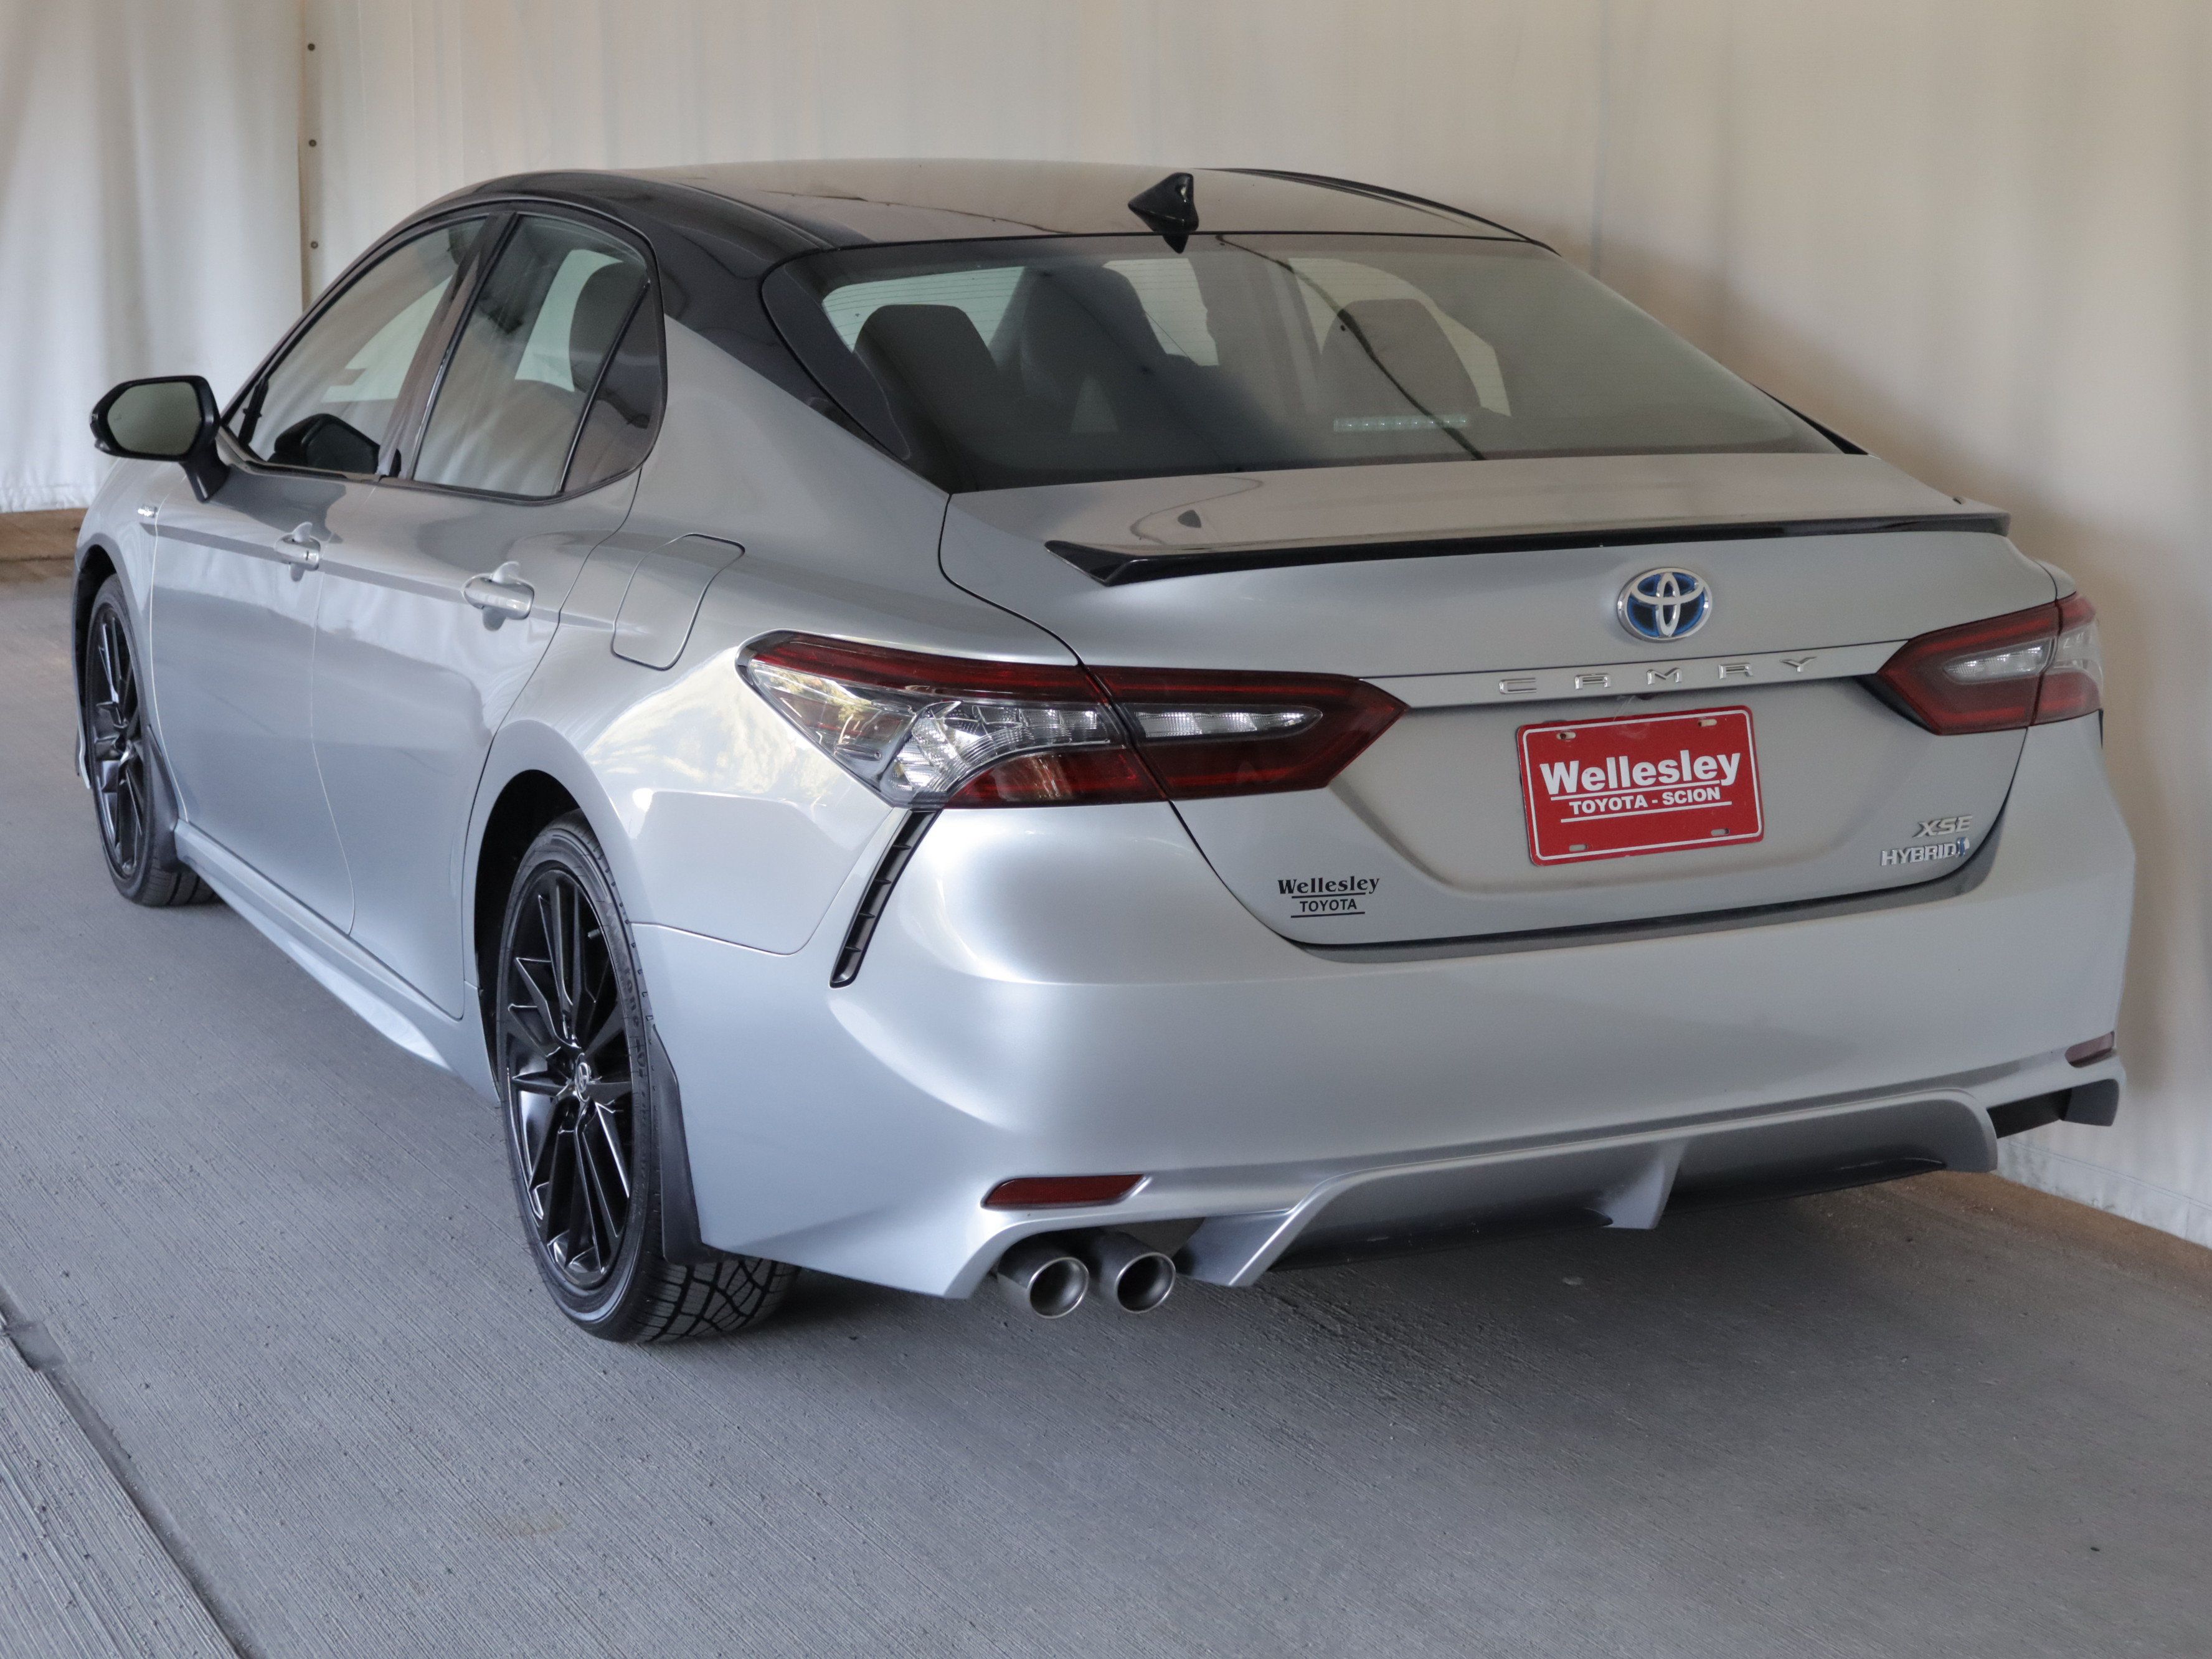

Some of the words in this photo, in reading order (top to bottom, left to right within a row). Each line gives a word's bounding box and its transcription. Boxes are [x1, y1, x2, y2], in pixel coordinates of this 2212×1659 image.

[1499, 656, 1817, 694] CAMRY
[1539, 749, 1741, 795] Wellesley
[1569, 796, 1648, 816] TOYOTA
[1661, 786, 1721, 805] SCION
[1912, 815, 1973, 838] XSE
[1880, 843, 1957, 866] HYBRID
[1277, 876, 1380, 894] Wellesley
[1299, 898, 1357, 912] TOYOTA
